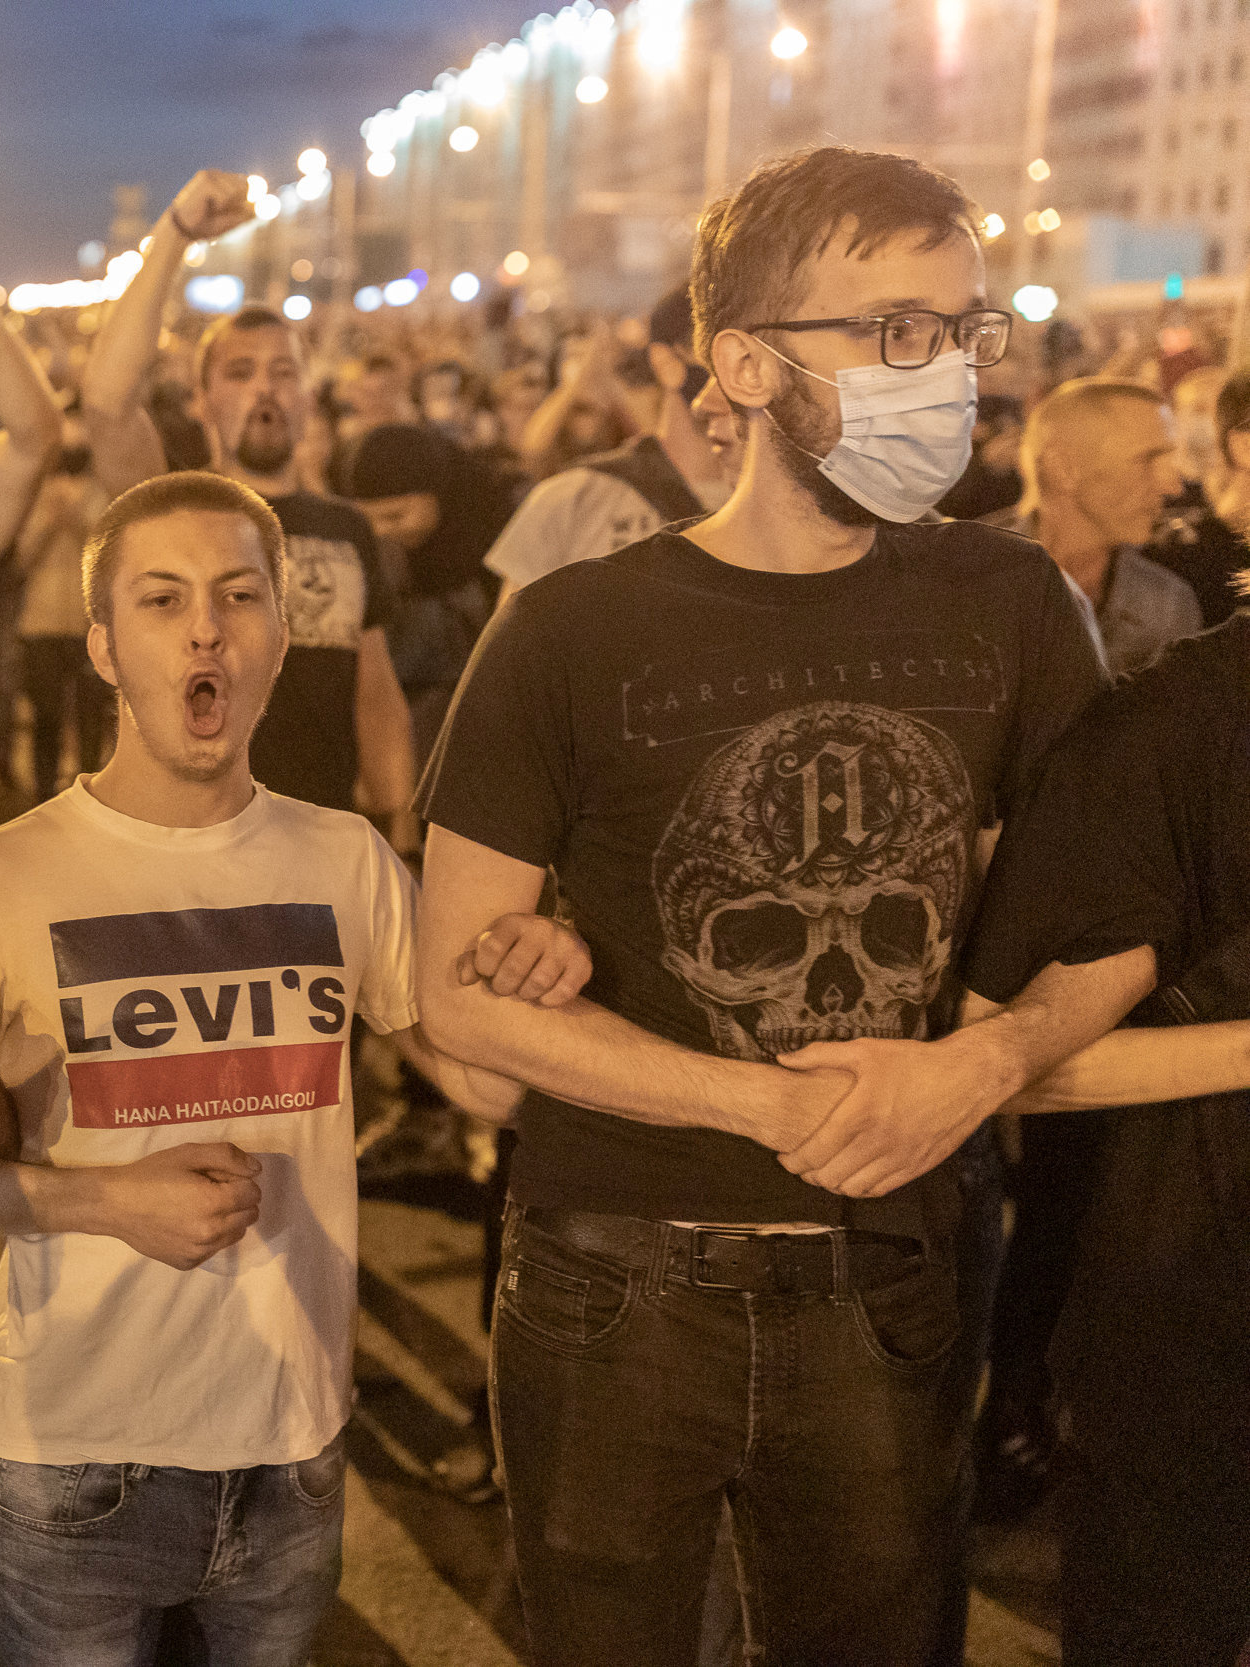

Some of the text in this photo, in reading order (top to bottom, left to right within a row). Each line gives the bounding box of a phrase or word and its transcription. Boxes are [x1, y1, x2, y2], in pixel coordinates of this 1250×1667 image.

[662, 658, 978, 711] ARCHITECTS
[114, 1091, 316, 1124] HANA HAITAODAIGOU
